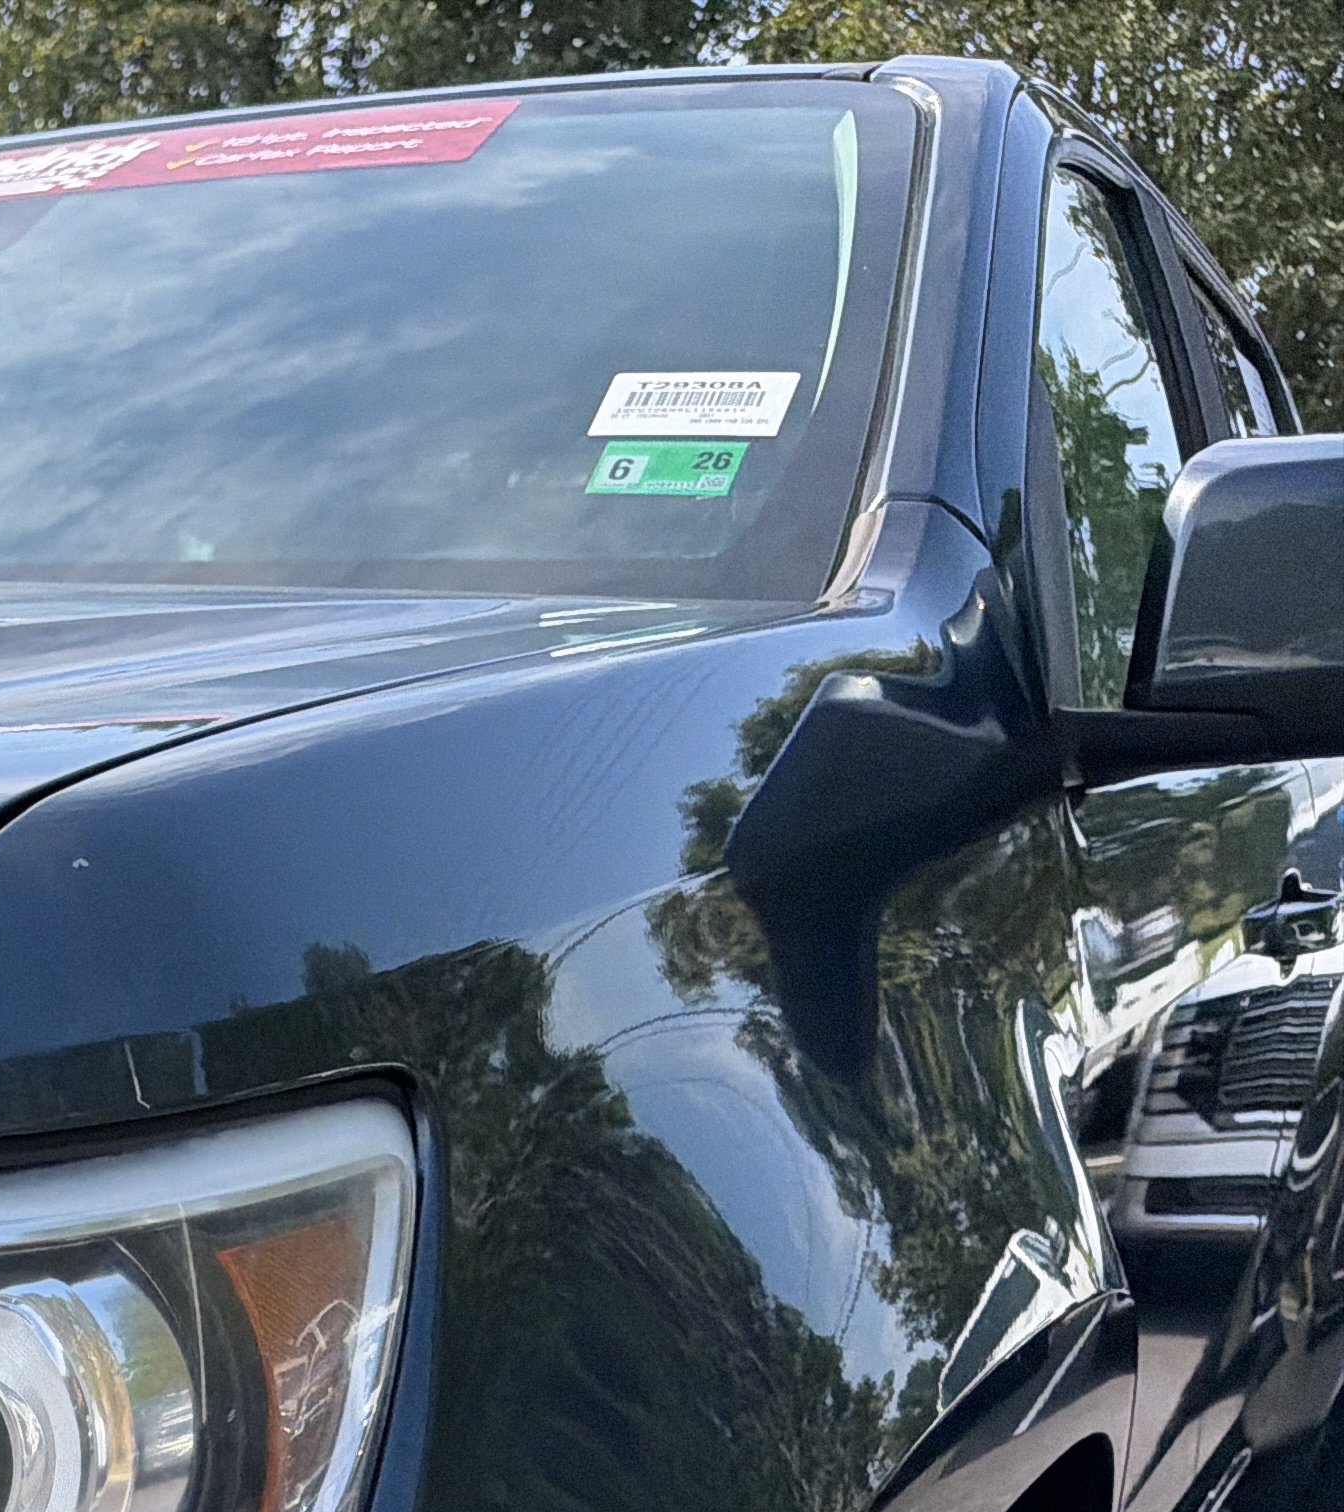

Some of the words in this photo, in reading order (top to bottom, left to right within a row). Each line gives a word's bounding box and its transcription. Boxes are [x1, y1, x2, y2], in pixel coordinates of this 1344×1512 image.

[306, 139, 423, 158] Report
[608, 458, 634, 480] 6
[692, 451, 734, 470] 26
